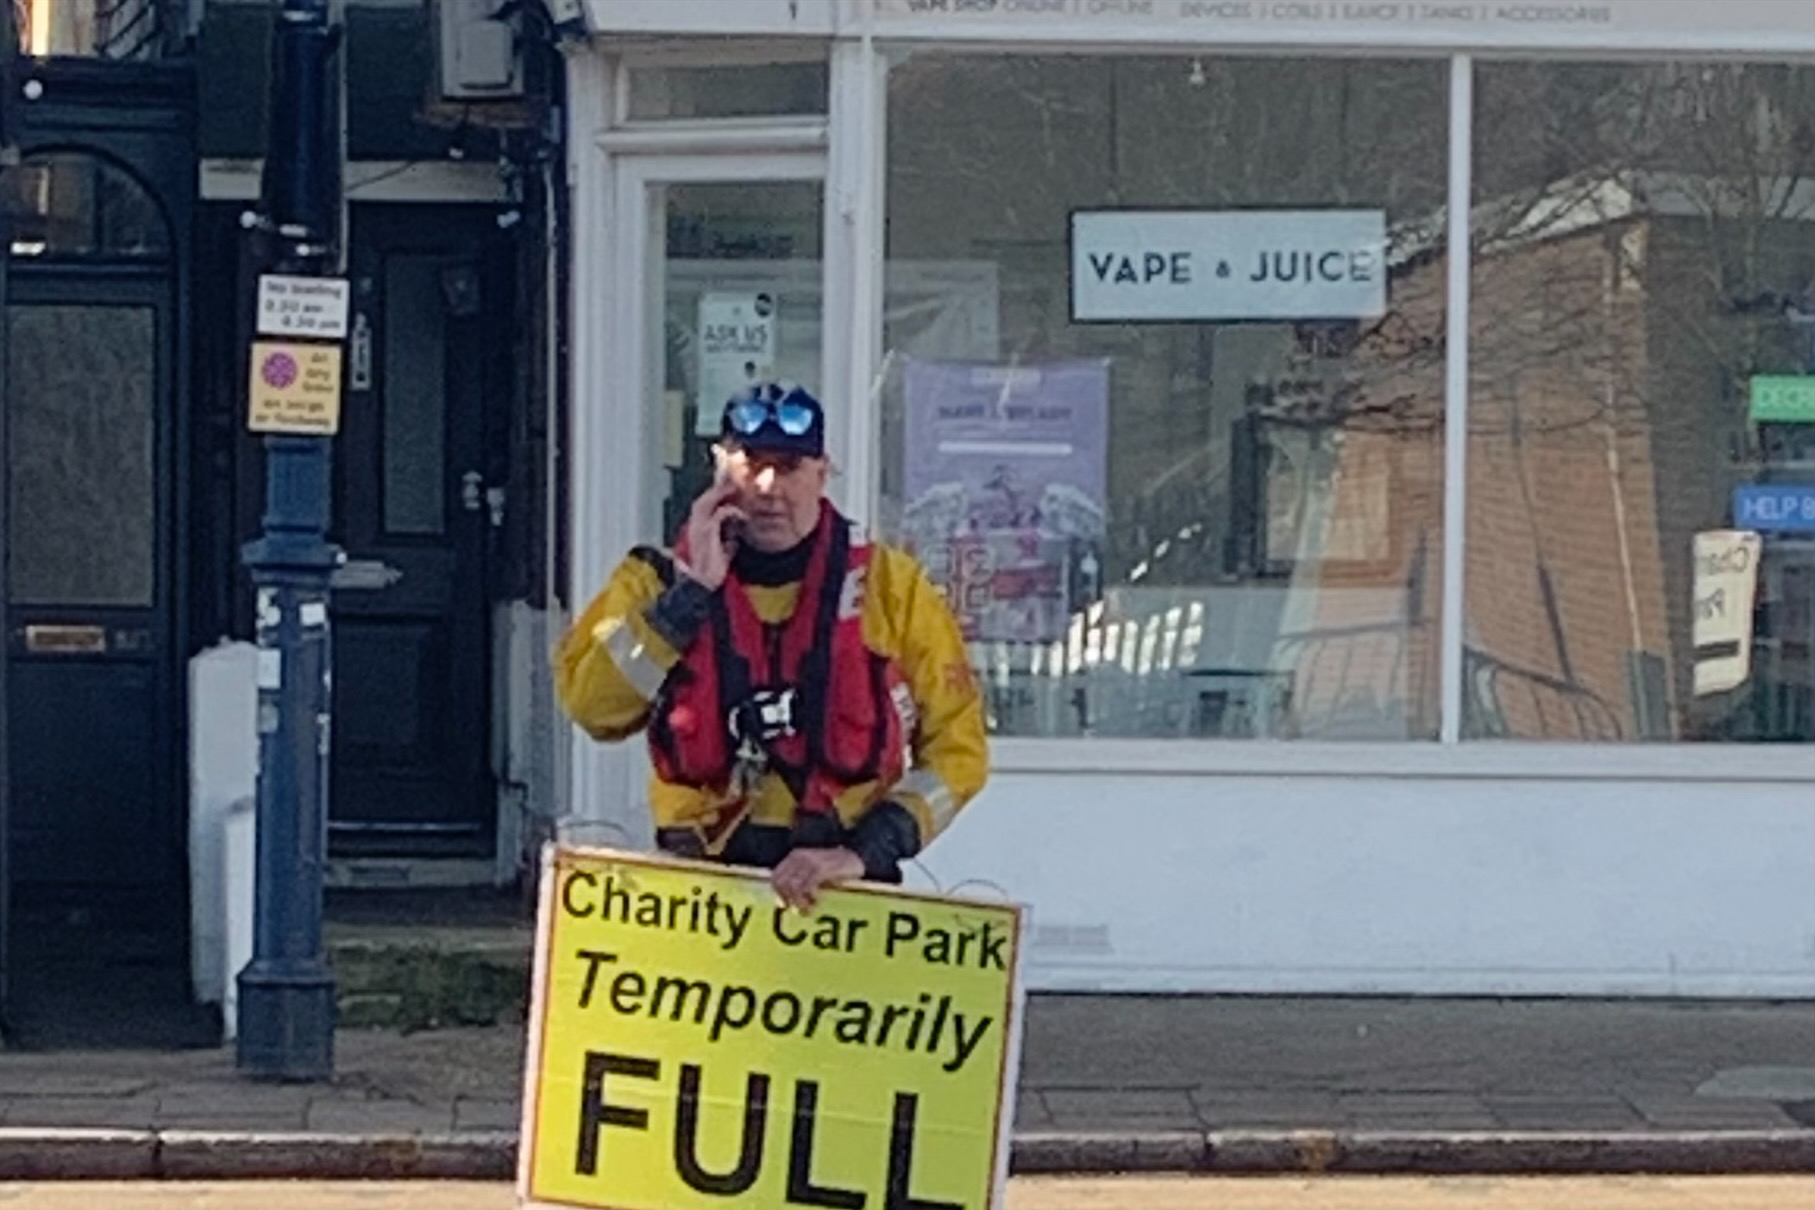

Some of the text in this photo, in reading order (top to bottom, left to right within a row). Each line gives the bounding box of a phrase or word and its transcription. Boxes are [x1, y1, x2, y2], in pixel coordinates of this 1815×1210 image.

[1088, 250, 1373, 284] VAPE & JUICE
[1743, 495, 1798, 520] HELP
[563, 870, 1009, 970] Charity Car Park
[574, 950, 993, 1072] Temporarily
